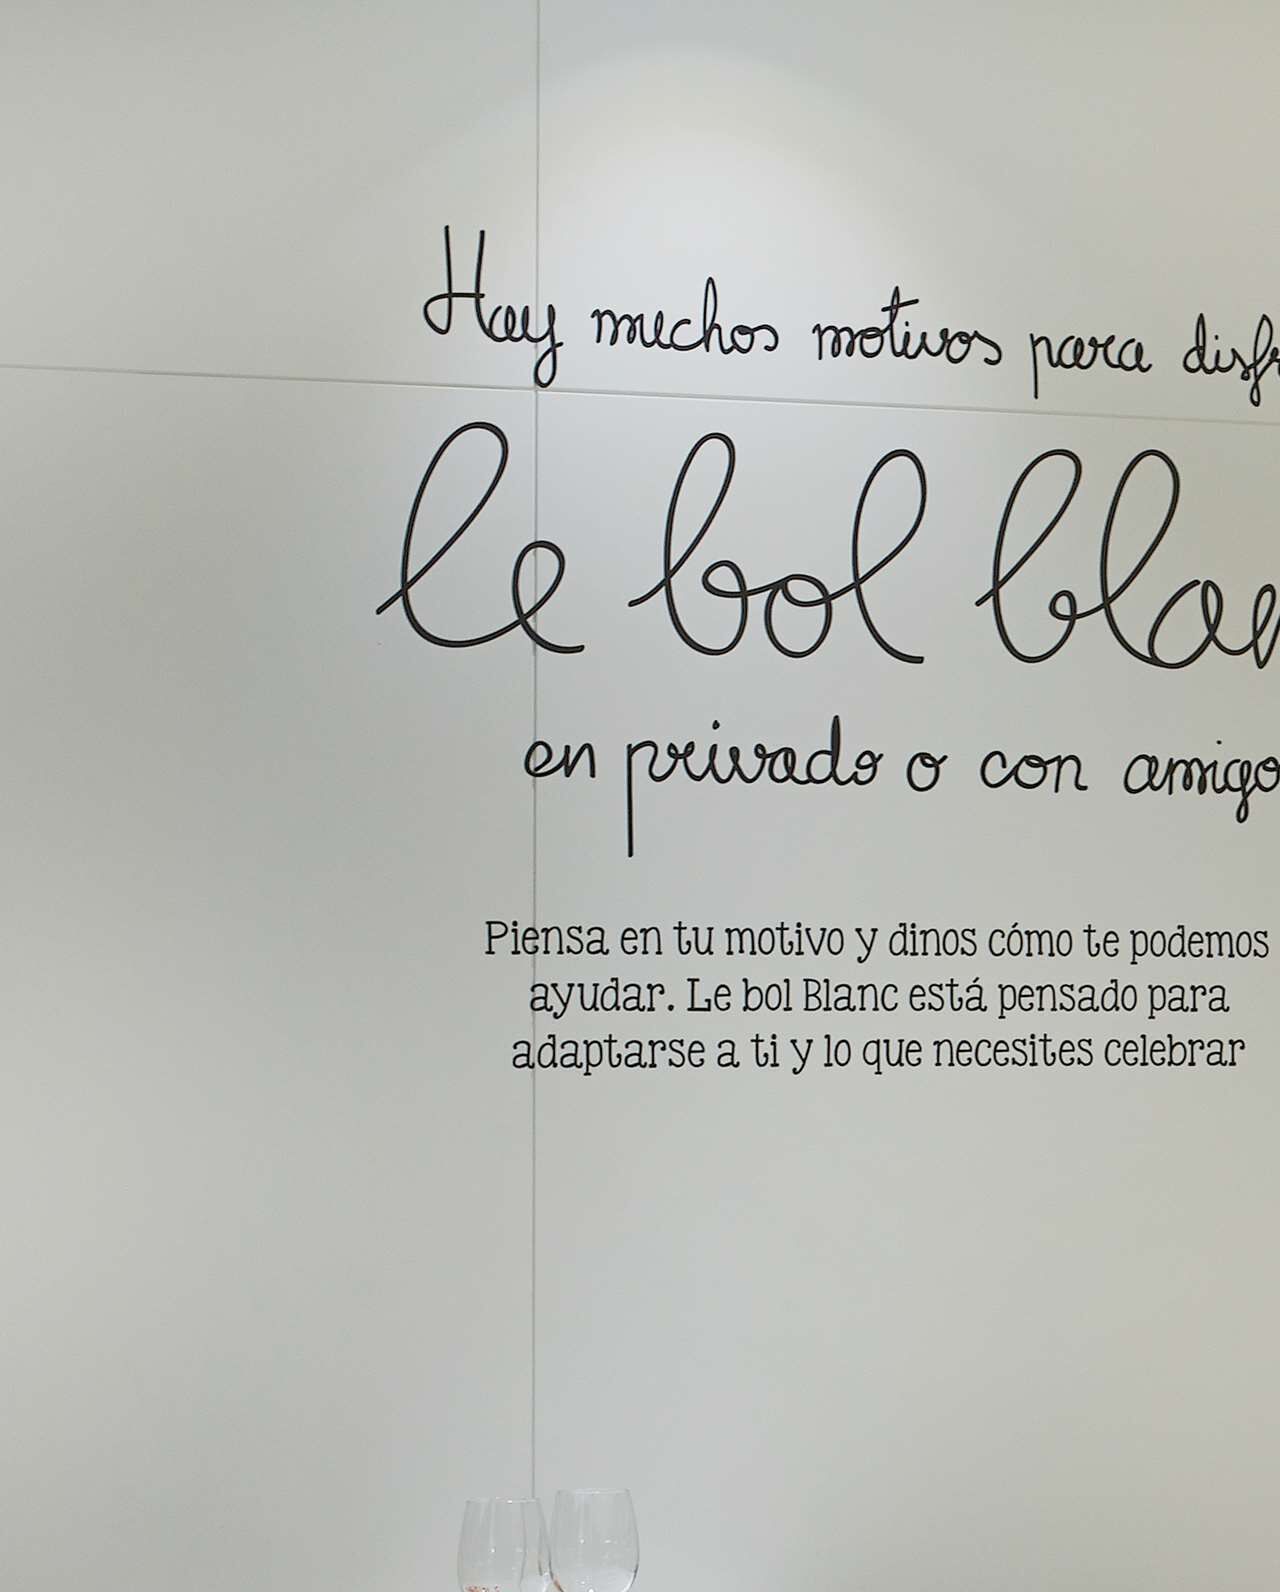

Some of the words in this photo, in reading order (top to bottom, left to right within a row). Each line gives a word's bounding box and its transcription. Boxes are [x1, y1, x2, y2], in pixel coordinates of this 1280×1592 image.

[422, 224, 565, 390] Hay
[589, 276, 780, 356] muchos
[811, 285, 1003, 366] motivos
[1028, 332, 1153, 401] para
[375, 421, 586, 657] le
[627, 431, 928, 665] bol
[523, 740, 597, 779] en
[625, 714, 885, 859] privado
[905, 751, 949, 793] o
[979, 750, 1089, 794] con
[484, 919, 611, 958] Piensa
[619, 926, 664, 956] en
[672, 920, 715, 956] tu
[724, 921, 845, 957] motivo
[854, 927, 879, 965] y
[888, 922, 978, 957] dinos
[987, 921, 1073, 958] cómo
[1082, 923, 1120, 958] te
[1129, 924, 1270, 966] podemos
[529, 976, 675, 1020] ayudar.
[686, 977, 732, 1013] Le
[741, 977, 793, 1013] bol
[802, 977, 899, 1013] Blanc
[908, 976, 989, 1013] está
[997, 978, 1138, 1020] pensado
[1147, 984, 1231, 1020] para
[511, 1033, 706, 1077] adaptarse
[716, 1039, 741, 1069] a
[749, 1032, 781, 1068] ti
[789, 1038, 814, 1076] y
[823, 1033, 852, 1068] lo
[862, 1038, 923, 1076] que
[932, 1032, 1094, 1068] necesites
[1103, 1033, 1246, 1068] celebrar
